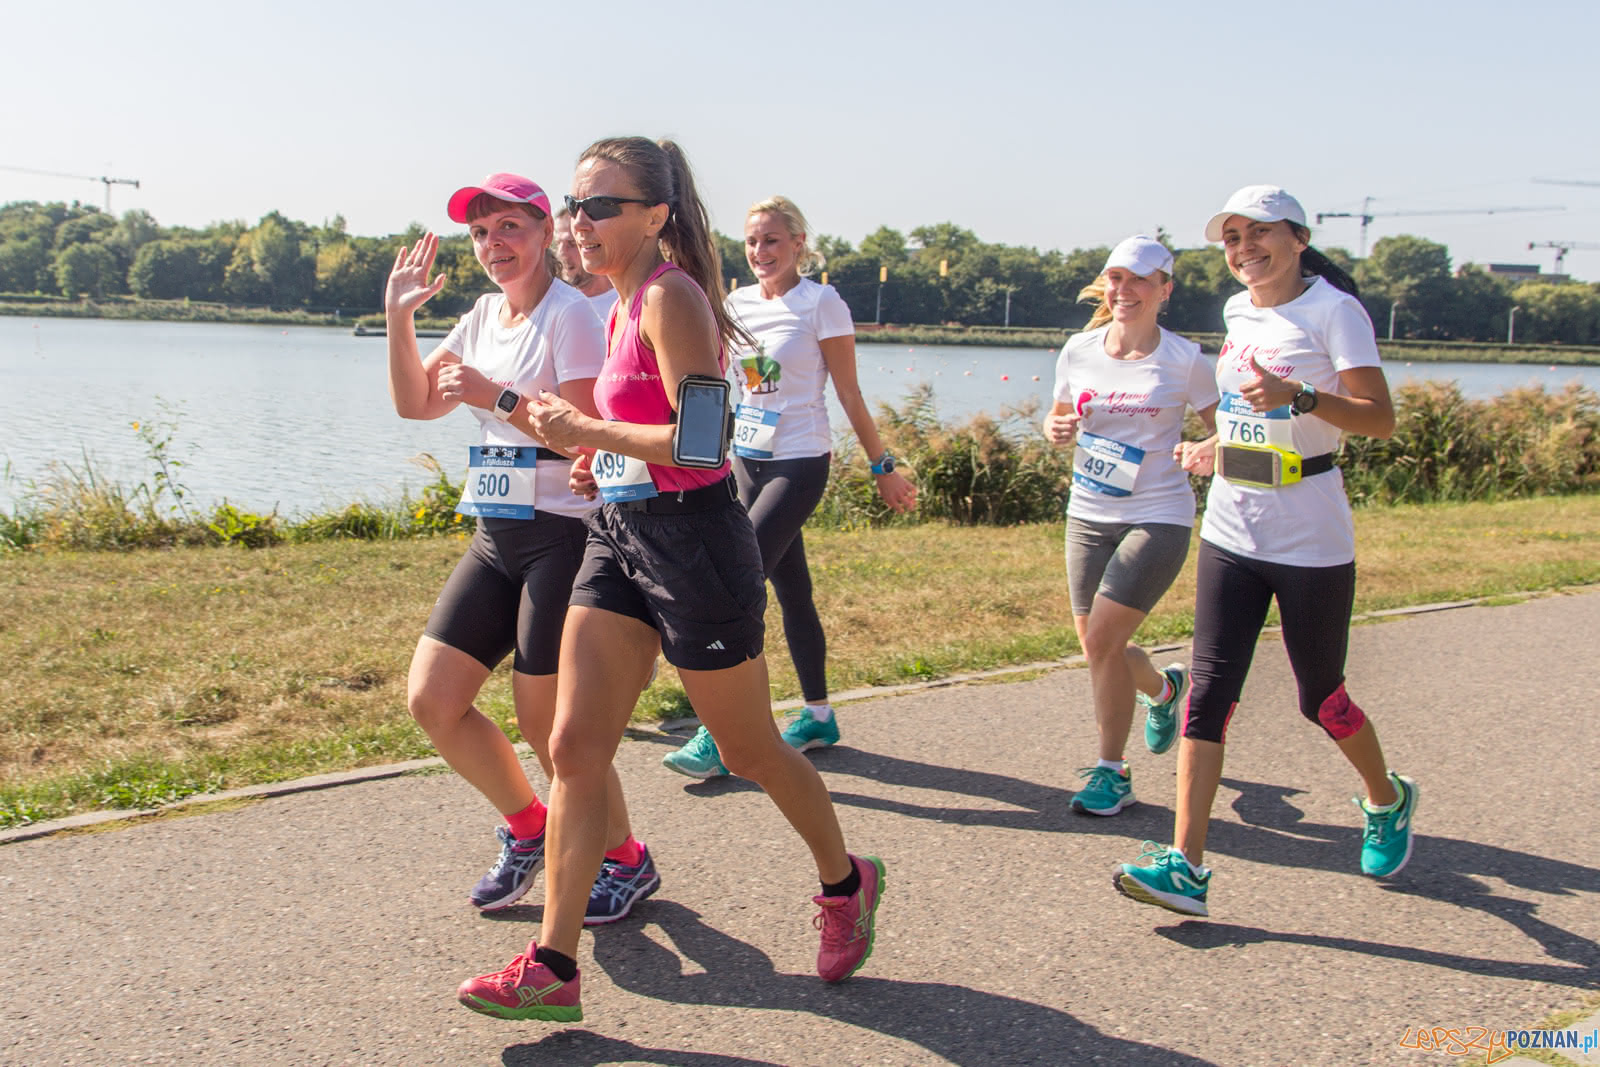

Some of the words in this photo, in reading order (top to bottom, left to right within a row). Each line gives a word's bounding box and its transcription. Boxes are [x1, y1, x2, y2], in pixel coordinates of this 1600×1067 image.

[1103, 391, 1150, 406] Mamy
[1108, 403, 1161, 418] Biegamy
[1229, 420, 1266, 444] 766
[595, 452, 625, 479] 499
[1084, 456, 1117, 479] 497
[477, 473, 510, 497] 500
